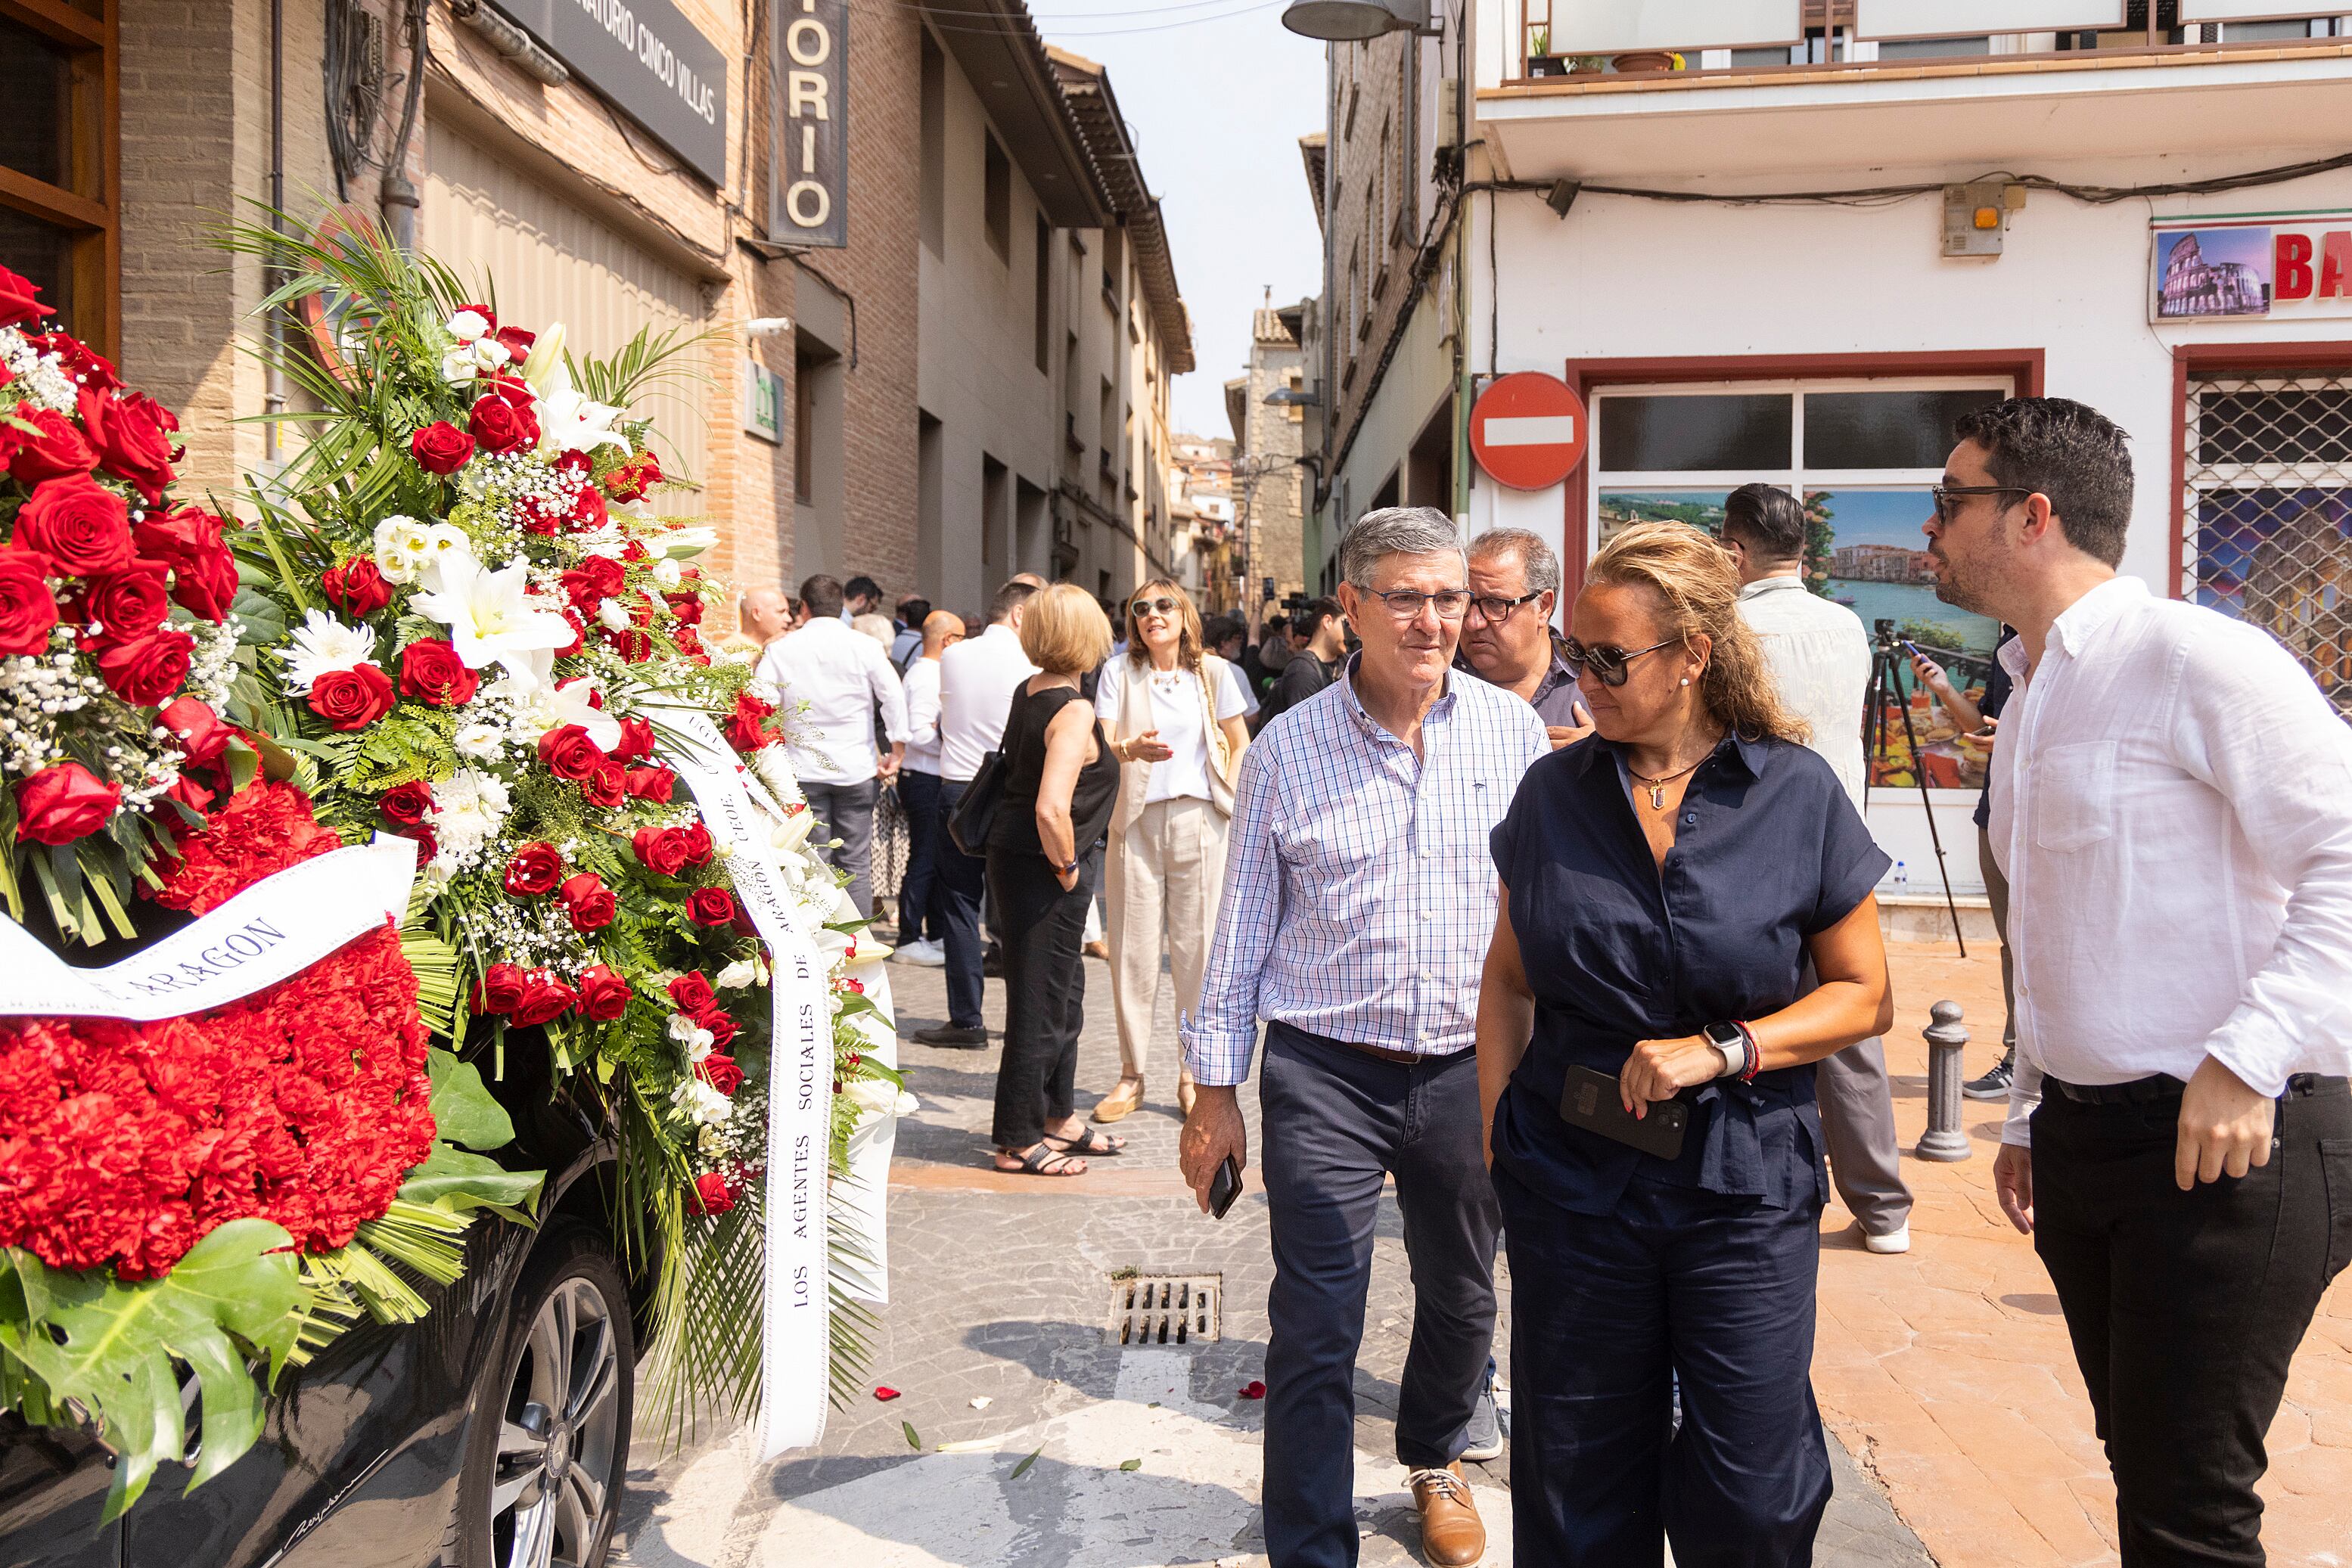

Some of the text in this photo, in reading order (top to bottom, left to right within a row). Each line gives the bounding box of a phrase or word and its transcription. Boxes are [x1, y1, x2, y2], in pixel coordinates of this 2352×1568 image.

[638, 23, 674, 88] CINCO
[677, 58, 715, 125] VILLAS
[787, 0, 831, 227] ORIO
[748, 861, 794, 933] ARAGON
[129, 916, 287, 996] ARAGON
[795, 955, 809, 979] DE
[799, 1004, 814, 1110] SOCIALES
[794, 1135, 809, 1239] AGENTES
[794, 1265, 808, 1308] LOS
